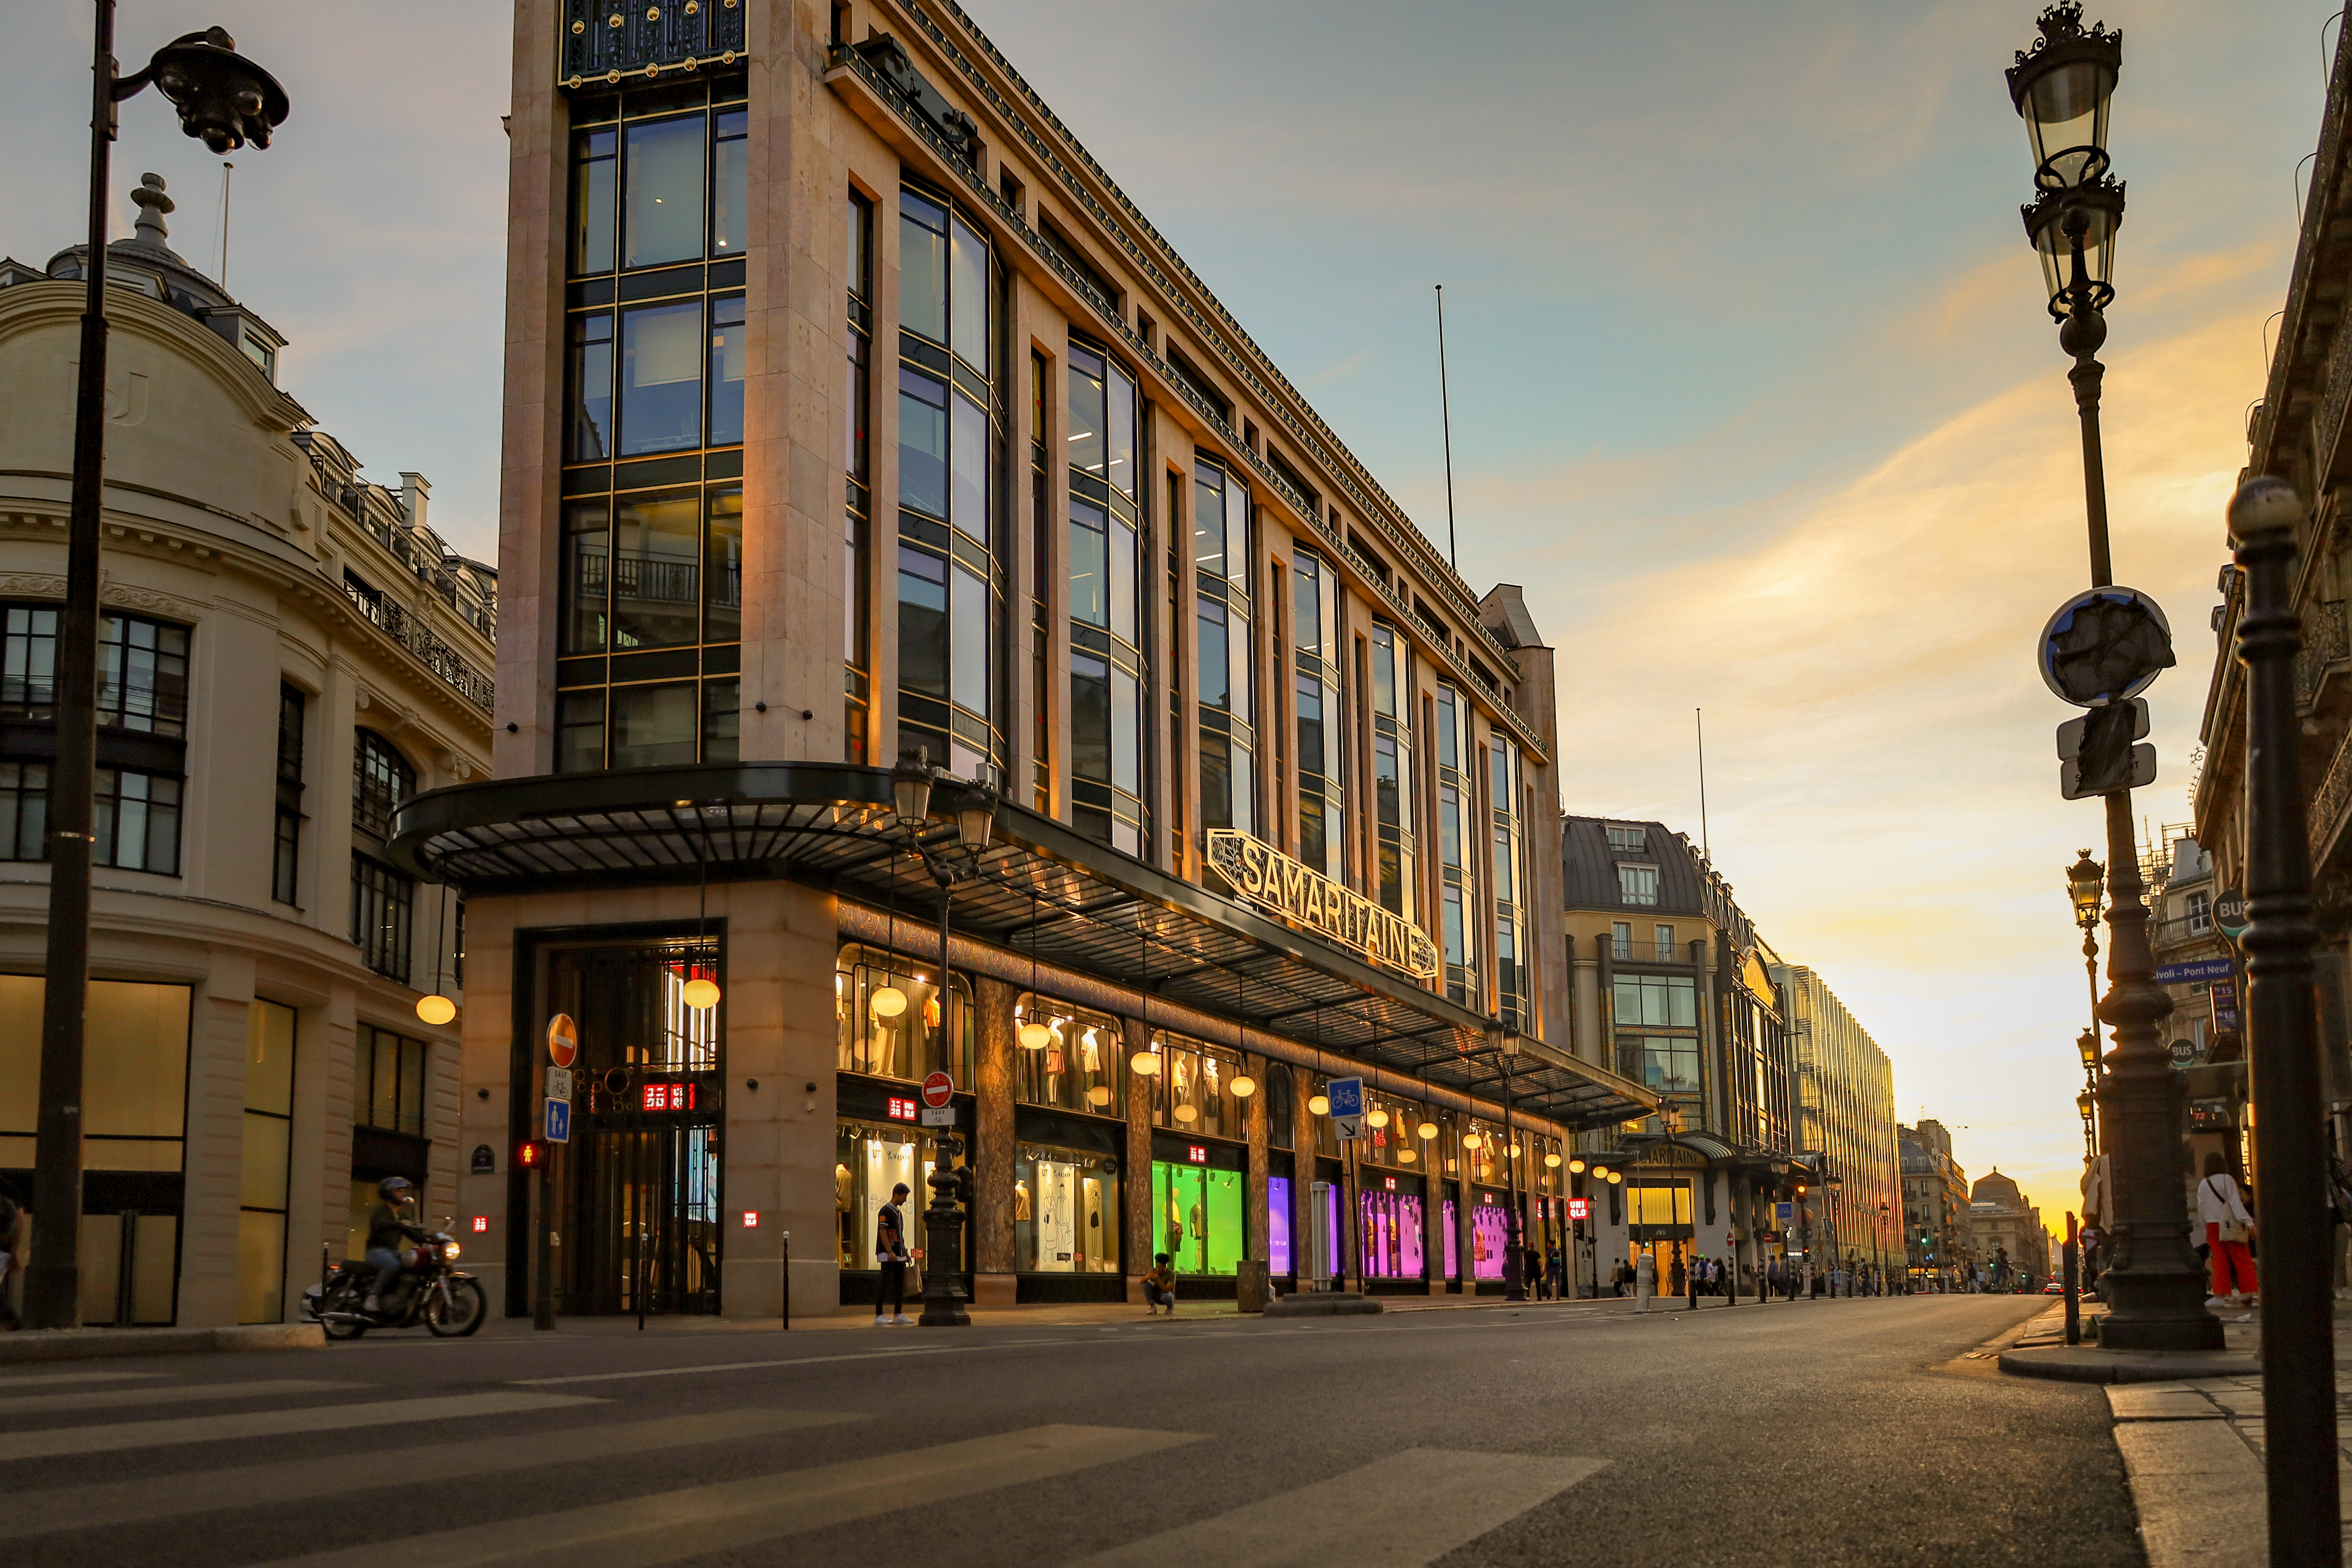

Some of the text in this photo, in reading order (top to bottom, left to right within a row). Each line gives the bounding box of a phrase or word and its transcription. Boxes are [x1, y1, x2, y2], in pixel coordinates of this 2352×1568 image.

[1242, 840, 1422, 972] SAMARITAINE
[2153, 969, 2175, 979] ivoli
[2184, 967, 2205, 977] Pont
[2207, 963, 2230, 974] Neuf
[2172, 1046, 2192, 1056] BUS
[555, 1070, 567, 1078] SAUF
[873, 1149, 880, 1159] UT
[1570, 1200, 1585, 1209] UNI
[1570, 1208, 1586, 1218] QLO
